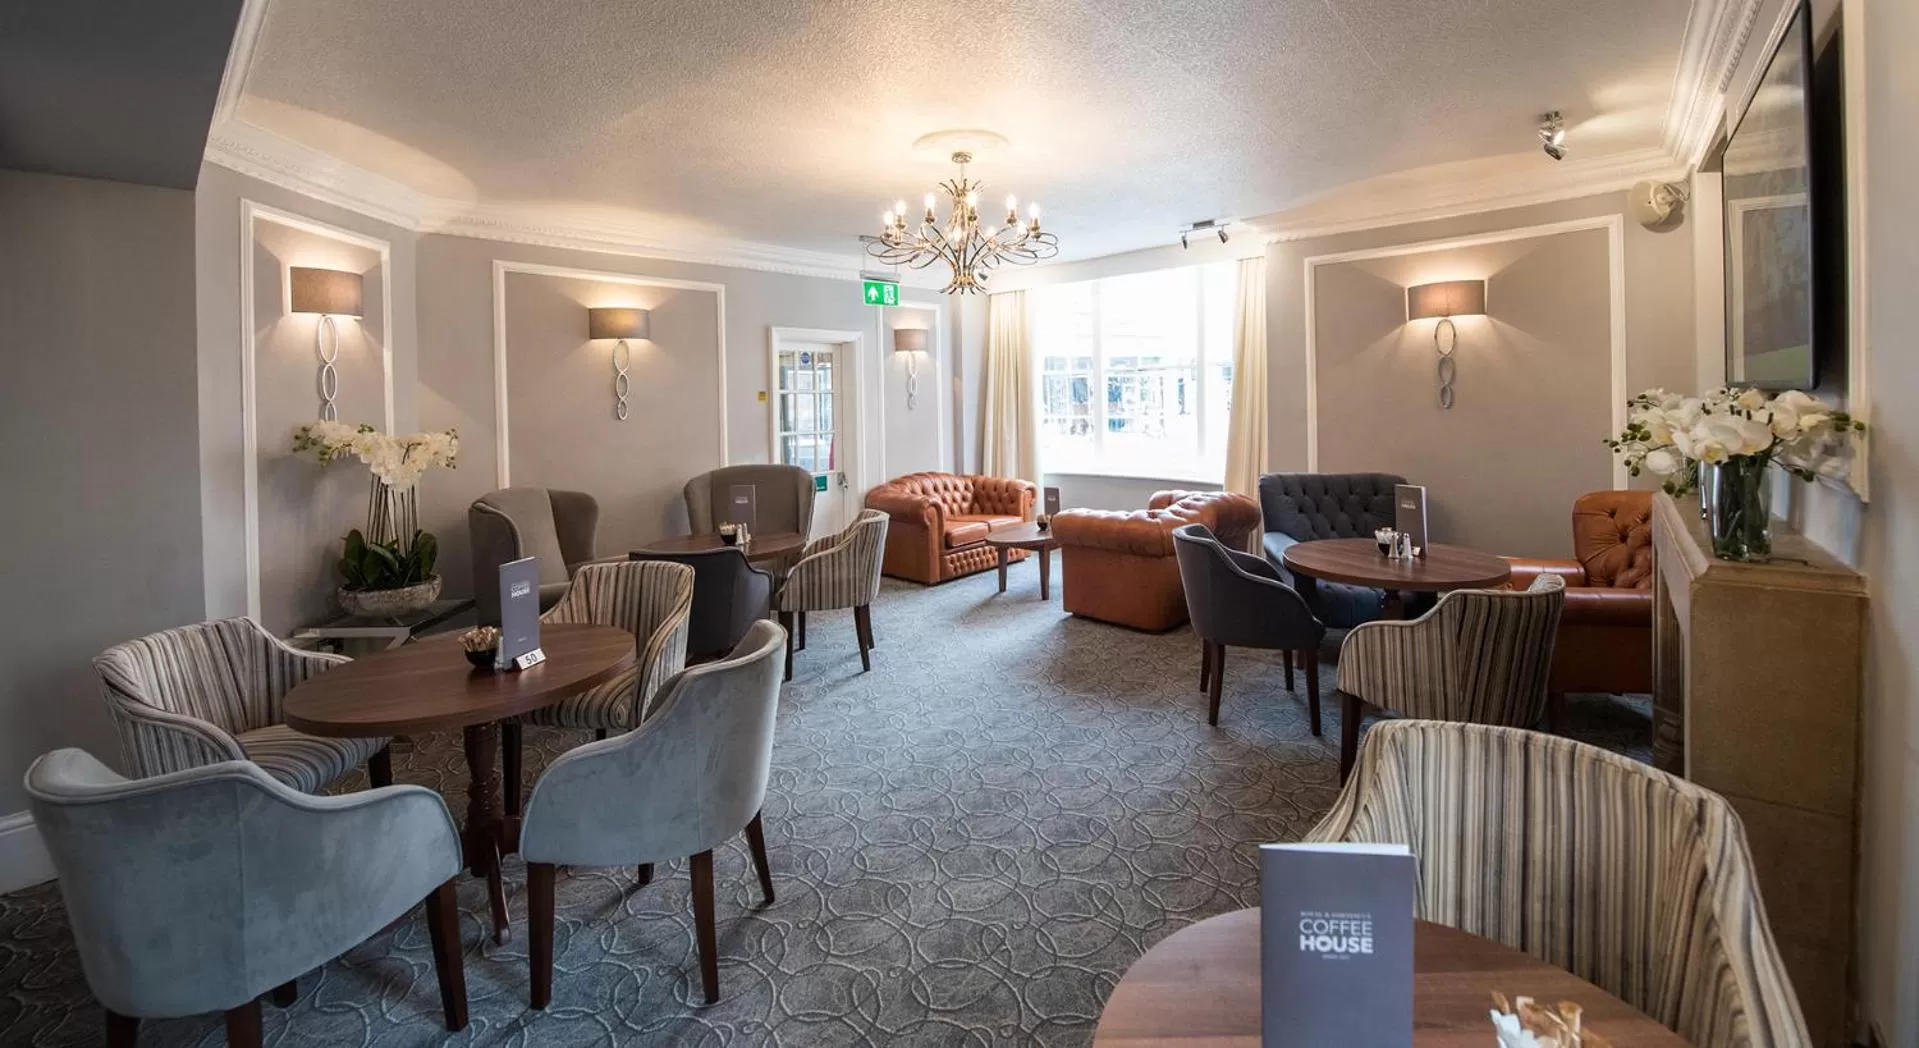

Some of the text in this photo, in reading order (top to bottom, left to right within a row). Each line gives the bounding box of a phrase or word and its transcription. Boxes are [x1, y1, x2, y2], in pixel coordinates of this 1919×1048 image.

[525, 653, 538, 665] 50
[1299, 919, 1372, 936] COFFEE
[1300, 935, 1373, 953] HOUSE
